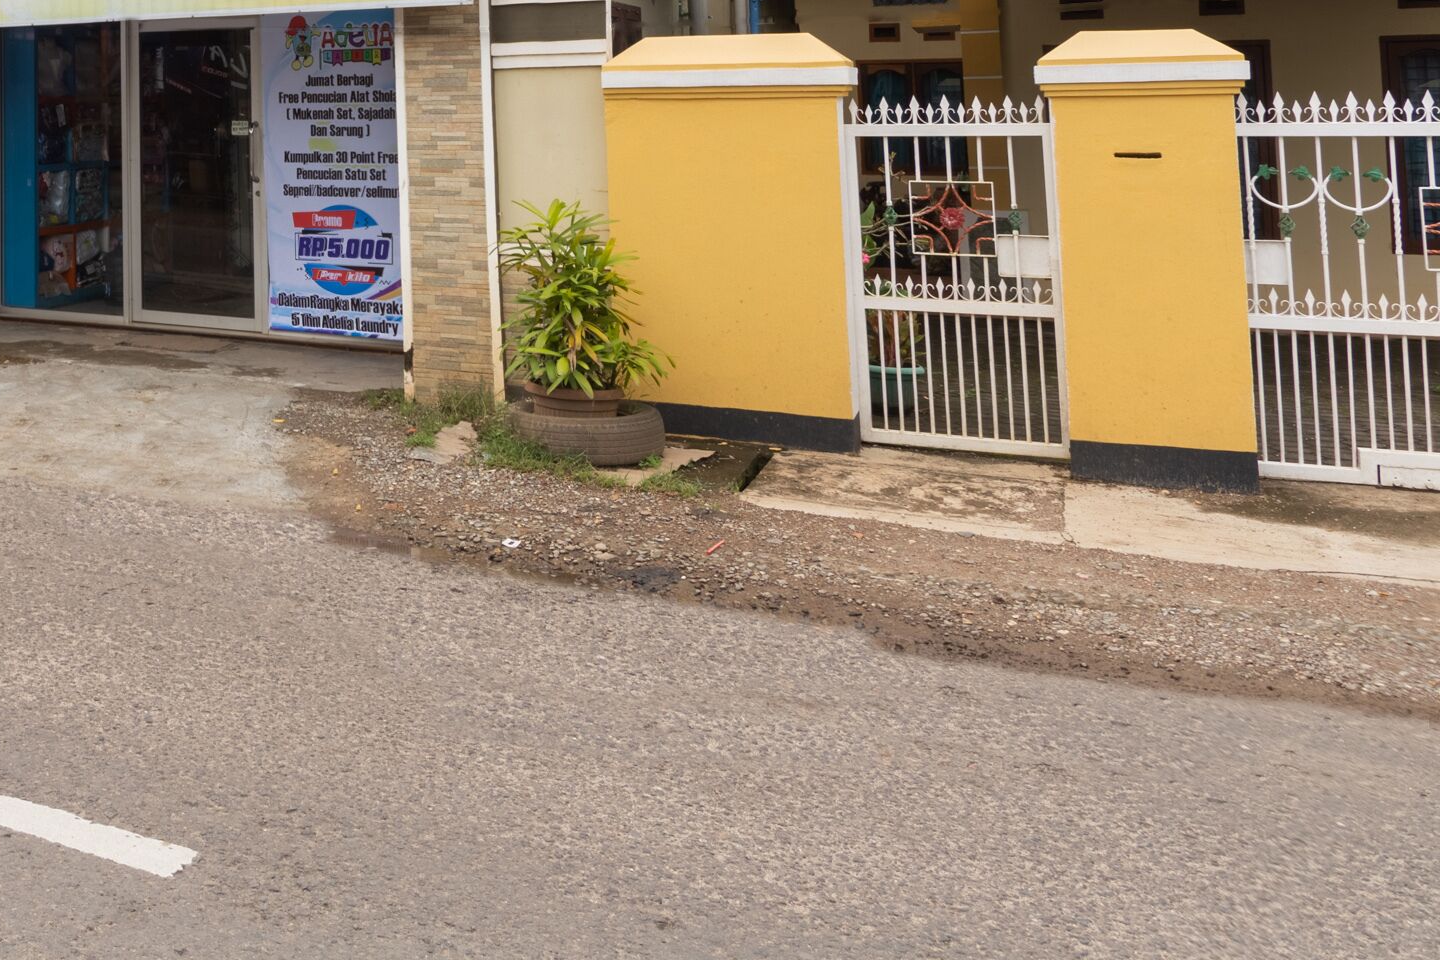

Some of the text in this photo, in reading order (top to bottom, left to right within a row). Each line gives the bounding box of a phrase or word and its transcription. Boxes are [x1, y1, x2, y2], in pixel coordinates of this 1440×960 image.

[306, 74, 374, 88] Jumat Berbagi
[278, 92, 299, 104] Free
[301, 92, 347, 104] Pencucian
[350, 91, 370, 103] Alat
[292, 108, 334, 120] Mukenah
[336, 108, 356, 120] Set,
[358, 107, 396, 121] Sajadah
[310, 124, 327, 137] Dan
[329, 124, 364, 138] Sarung
[284, 151, 334, 165] Kumpulkan
[335, 151, 348, 163] 30
[350, 151, 375, 164] Point
[296, 167, 386, 181] Pencucian Satu Set
[312, 213, 342, 227] Promo
[327, 238, 390, 260] 5.000
[316, 270, 371, 282] Per kilo
[278, 292, 309, 307] Dalam
[310, 295, 350, 311] Rangka
[291, 313, 299, 326] 5
[322, 314, 354, 330] Adelia
[355, 317, 398, 336] Laundry
